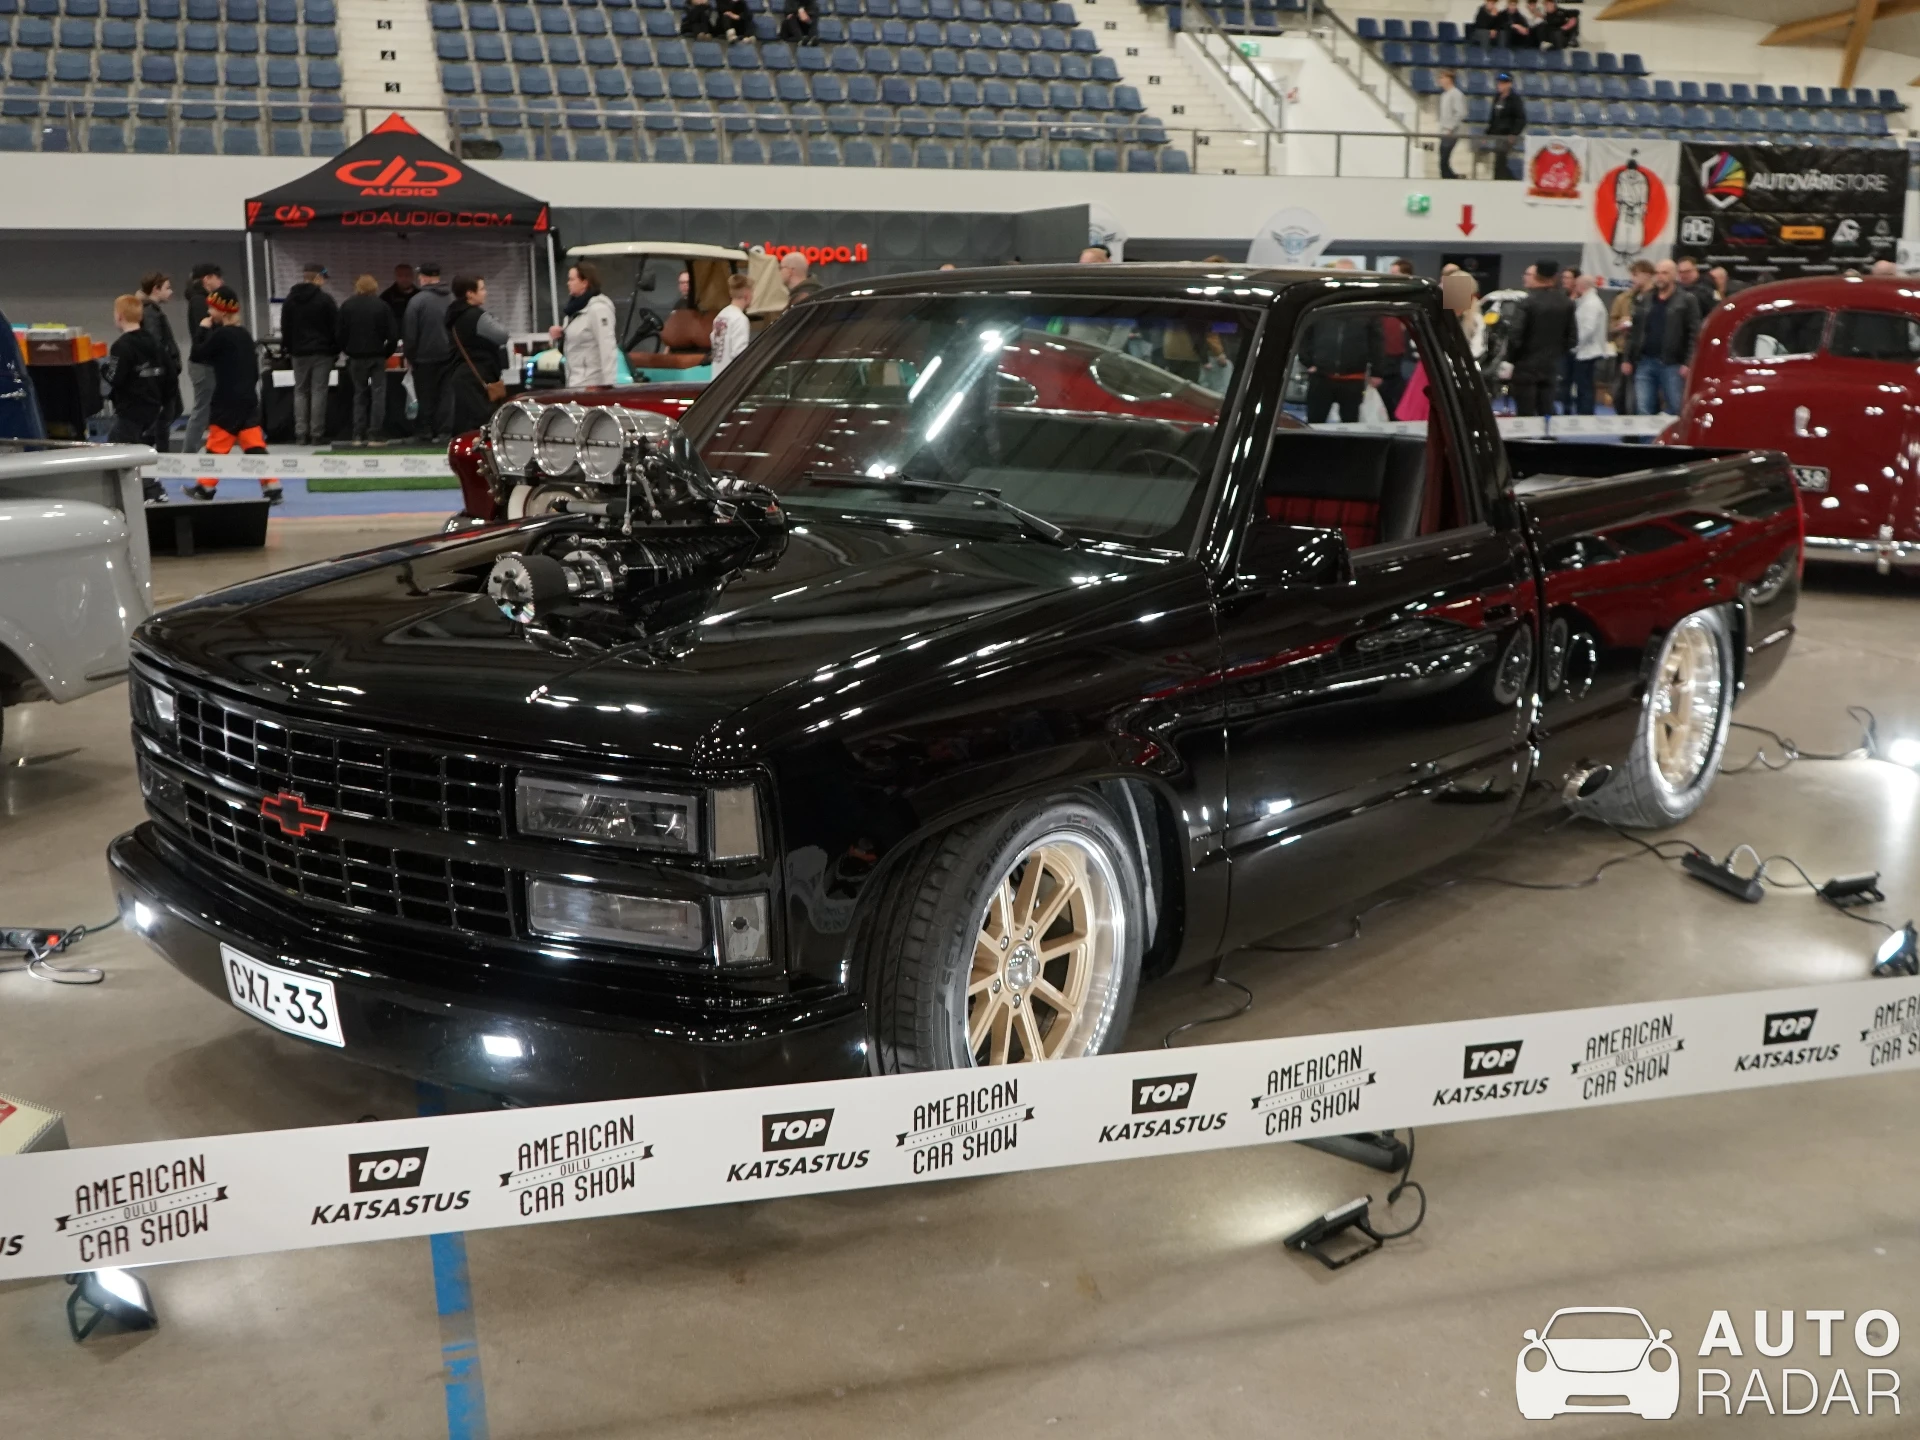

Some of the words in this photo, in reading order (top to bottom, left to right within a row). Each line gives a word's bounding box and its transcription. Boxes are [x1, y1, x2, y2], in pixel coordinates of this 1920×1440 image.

[360, 187, 439, 197] AUDIO
[341, 211, 512, 228] DDAUDIO.COM
[229, 959, 328, 1030] CXZ-33
[1586, 1013, 1673, 1061] AMERICAN
[1769, 1016, 1812, 1038] TOP
[1470, 1048, 1517, 1070] TOP
[1734, 1044, 1840, 1072] KATSASTUS
[1871, 1037, 1901, 1067] CAR
[1267, 1045, 1362, 1095] AMERICAN
[1583, 1072, 1616, 1100] CAR
[1624, 1054, 1670, 1088] SHOW
[913, 1079, 1018, 1132] AMERICAN
[1139, 1082, 1190, 1106] TOP
[1432, 1077, 1550, 1106] KATSASTUS
[1098, 1112, 1228, 1143] KATSASTUS
[1265, 1105, 1302, 1136] CAR
[1310, 1087, 1360, 1124] SHOW
[517, 1115, 634, 1171] AMERICAN
[770, 1117, 827, 1143] TOP
[726, 1149, 871, 1182] KATSASTUS
[913, 1142, 953, 1175] CAR
[962, 1124, 1018, 1161] SHOW
[75, 1153, 206, 1214] AMERICAN
[357, 1156, 421, 1183] TOP
[519, 1181, 565, 1216] CAR
[575, 1162, 635, 1202] SHOW
[123, 1200, 158, 1220] OULU
[310, 1190, 471, 1226] KATSASTUS
[79, 1225, 130, 1263] CAR
[140, 1203, 209, 1247] SHOW
